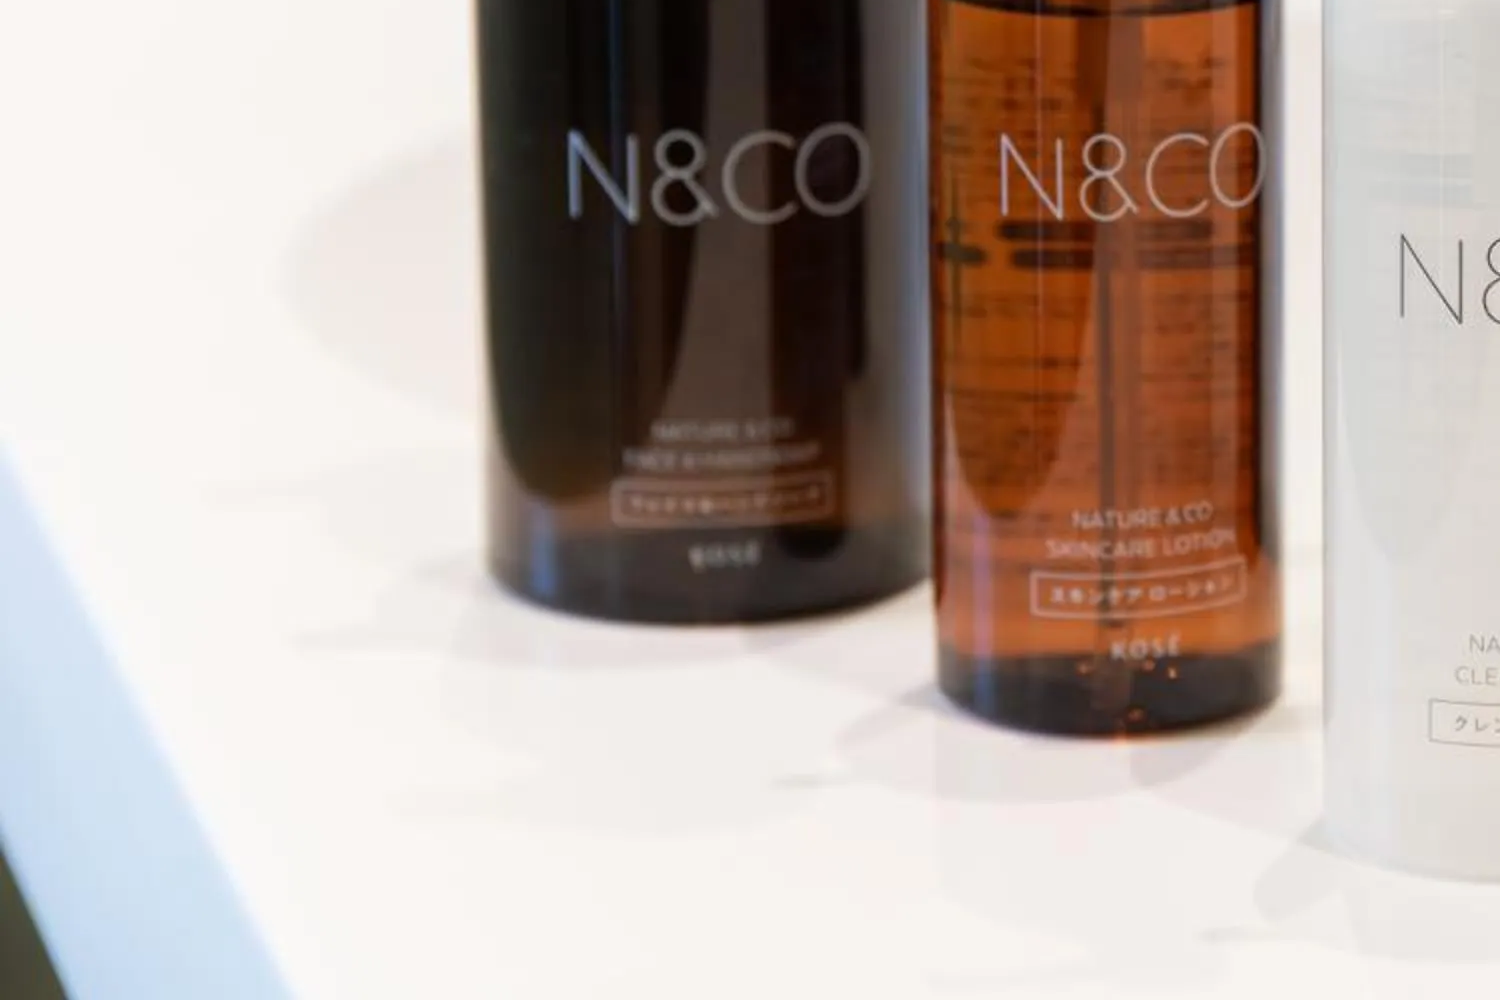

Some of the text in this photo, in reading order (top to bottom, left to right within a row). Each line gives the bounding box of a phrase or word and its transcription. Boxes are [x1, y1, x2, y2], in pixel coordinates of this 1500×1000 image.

[567, 121, 871, 227] N&CO
[1000, 121, 1266, 222] N&CO
[1045, 527, 1236, 560] SKINCARE LOTION
[1071, 508, 1160, 529] NATURE
